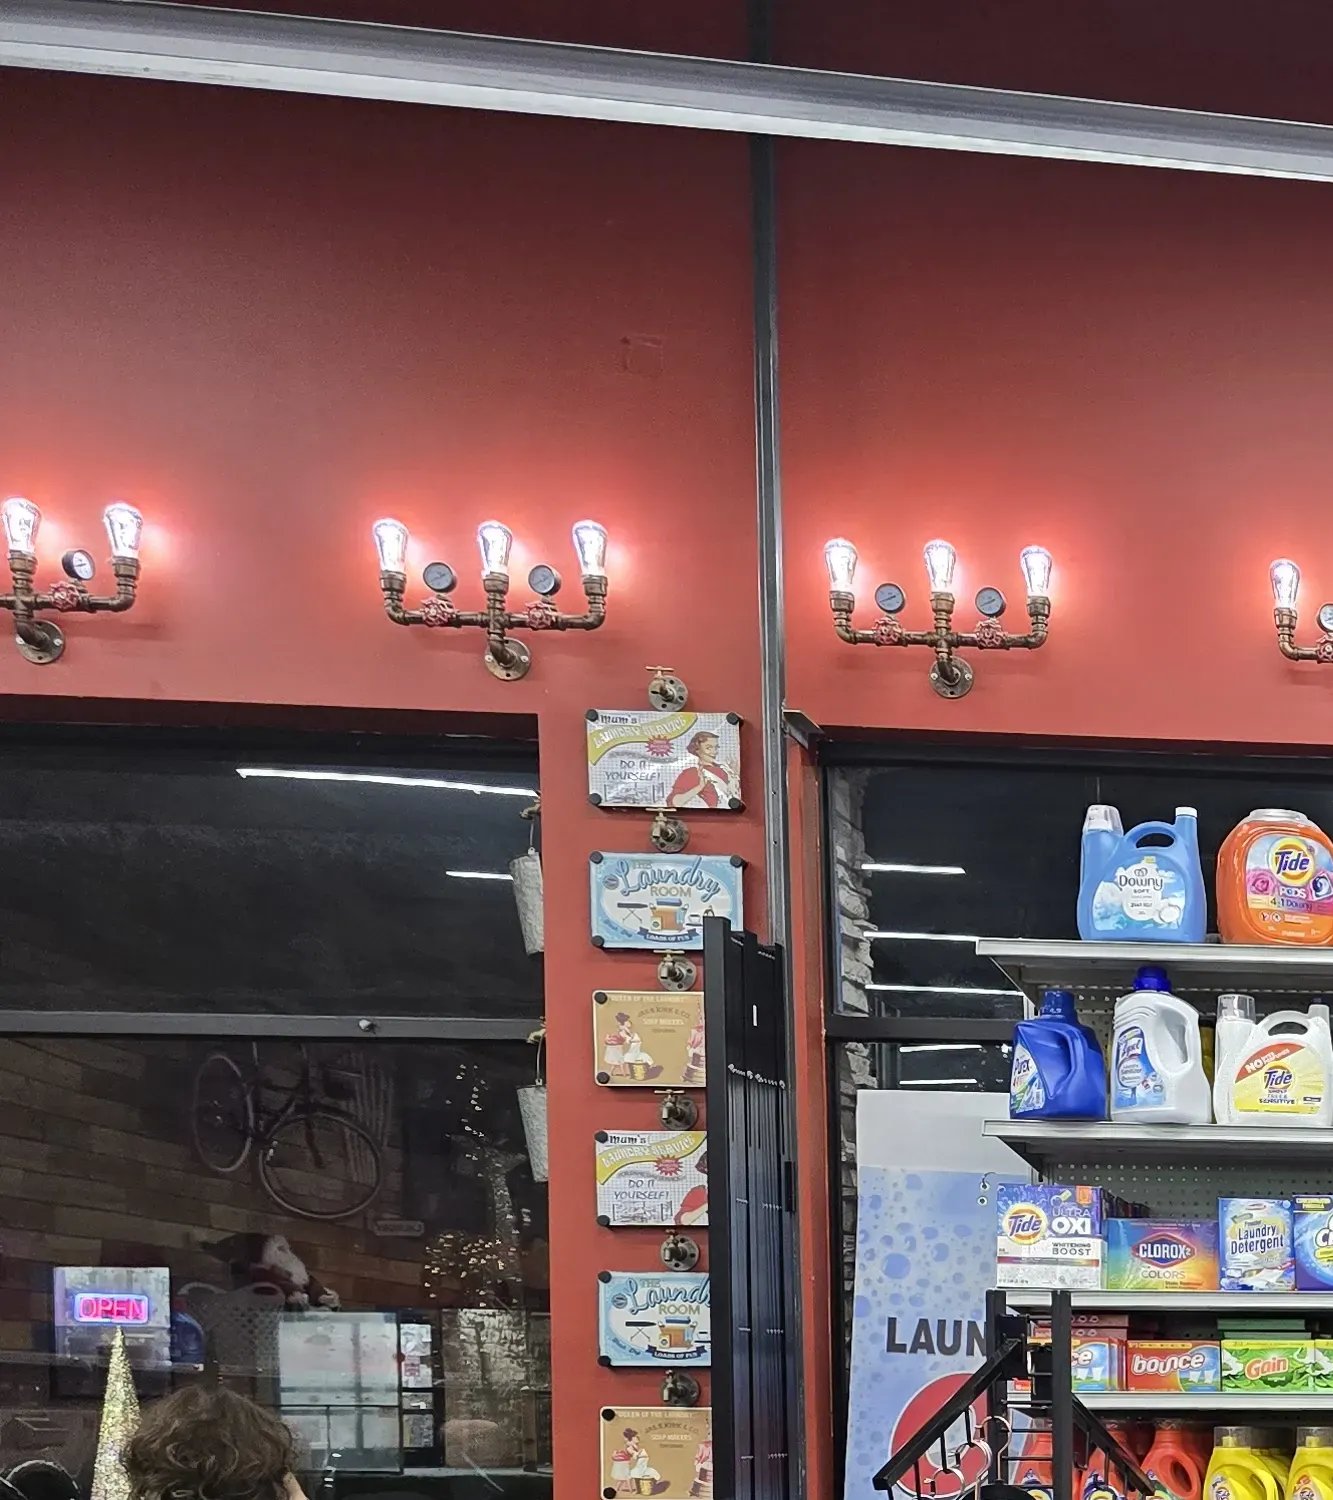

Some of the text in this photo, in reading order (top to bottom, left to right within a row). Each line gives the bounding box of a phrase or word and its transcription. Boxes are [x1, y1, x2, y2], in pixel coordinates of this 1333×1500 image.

[599, 714, 638, 725] Mum's
[593, 715, 686, 749] LAUNDRY SERVICE
[620, 760, 635, 770] DO
[605, 769, 661, 781] YOURSELF!
[1275, 850, 1309, 874] Tide
[617, 855, 721, 901] Laundry
[1118, 875, 1163, 890] Downy
[650, 887, 691, 897] ROOM
[1264, 1069, 1292, 1089] Tide
[609, 1135, 646, 1145] Mum's
[601, 1135, 695, 1168] LAUNDRY SERVICE
[628, 1180, 643, 1189] DO
[614, 1191, 669, 1200] YOURSELF!
[1052, 1208, 1090, 1217] ULTRA
[1008, 1213, 1042, 1236] Tide
[1052, 1217, 1091, 1235] OXI
[1238, 1224, 1277, 1241] Laundry
[1052, 1248, 1091, 1256] BOOST
[1230, 1235, 1284, 1255] Detergent
[1142, 1270, 1186, 1279] COLORS
[640, 1279, 661, 1288] THE
[78, 1297, 148, 1321] OPEN
[659, 1305, 700, 1315] ROOM
[1132, 1353, 1205, 1376] bounce
[1245, 1356, 1289, 1379] Gain
